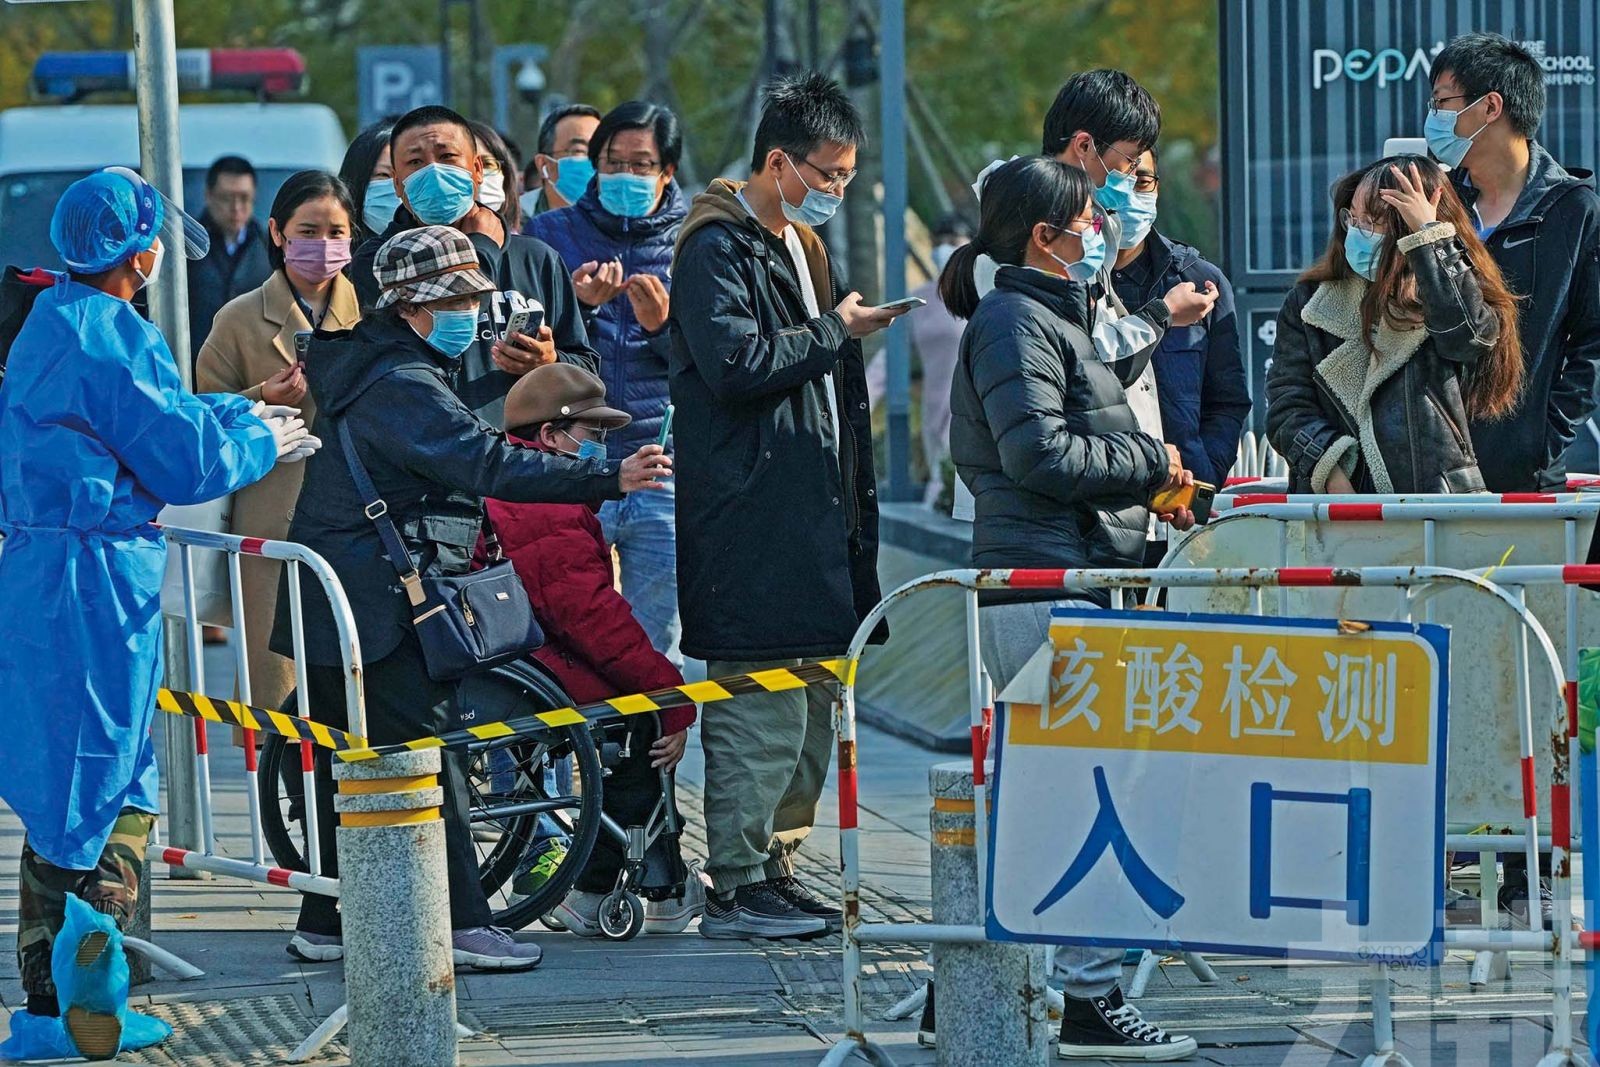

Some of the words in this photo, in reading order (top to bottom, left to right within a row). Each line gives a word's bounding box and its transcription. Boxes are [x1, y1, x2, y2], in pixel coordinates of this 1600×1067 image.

[1039, 637, 1398, 746] 核酸检测
[1033, 765, 1371, 926] 入口
